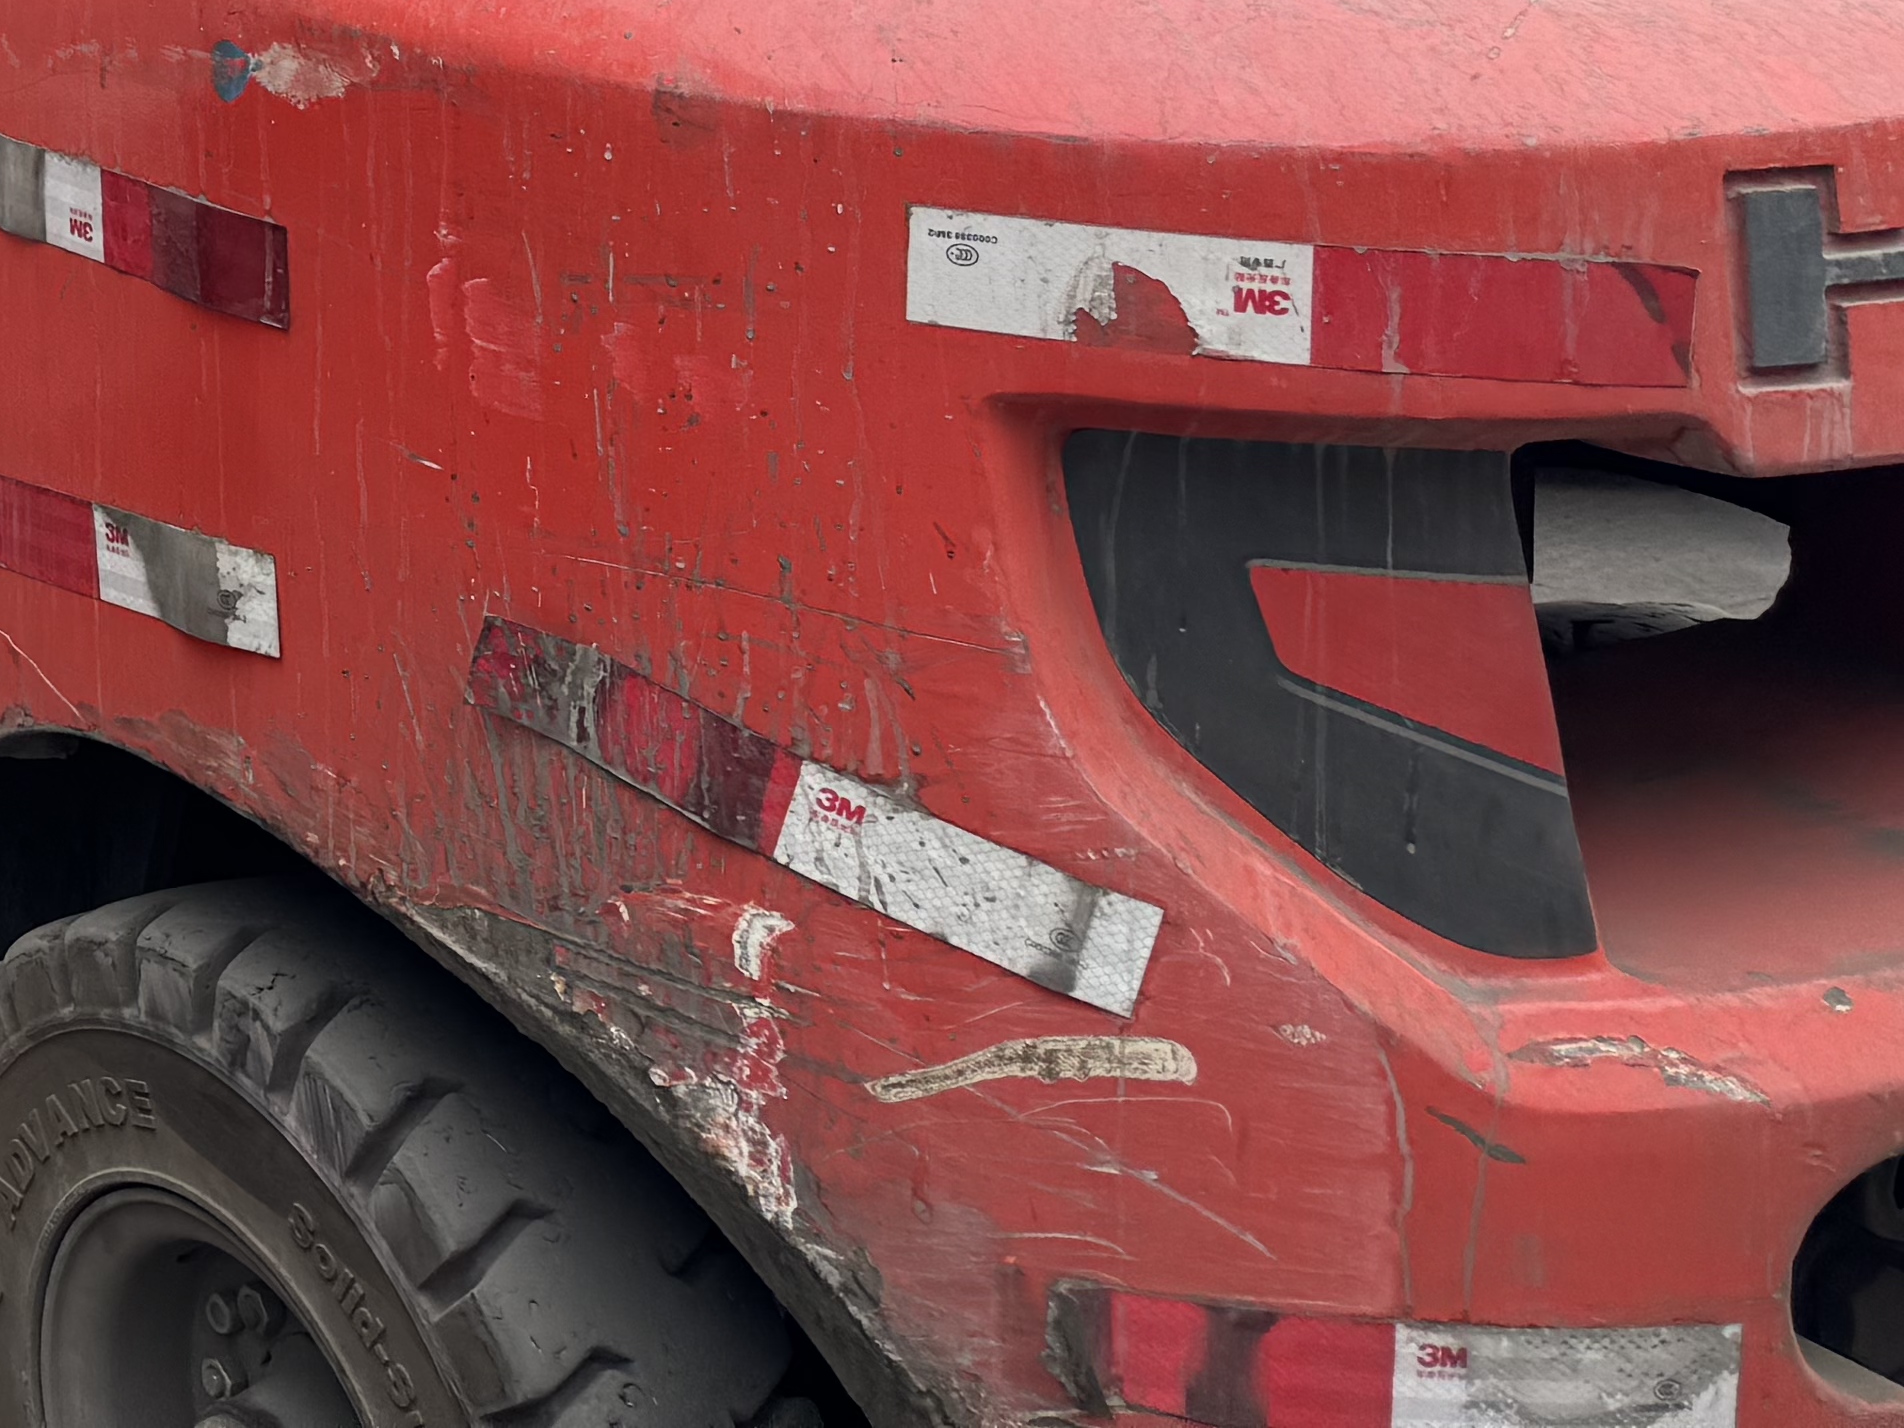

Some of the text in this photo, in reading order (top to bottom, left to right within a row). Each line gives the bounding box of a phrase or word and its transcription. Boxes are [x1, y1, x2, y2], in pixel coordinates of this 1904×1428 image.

[69, 216, 94, 243] 3M
[1233, 287, 1292, 316] 3M
[104, 521, 130, 547] 3M
[815, 787, 867, 826] 3M
[290, 1201, 428, 1428] Solid-S
[1416, 1343, 1468, 1370] 3M
